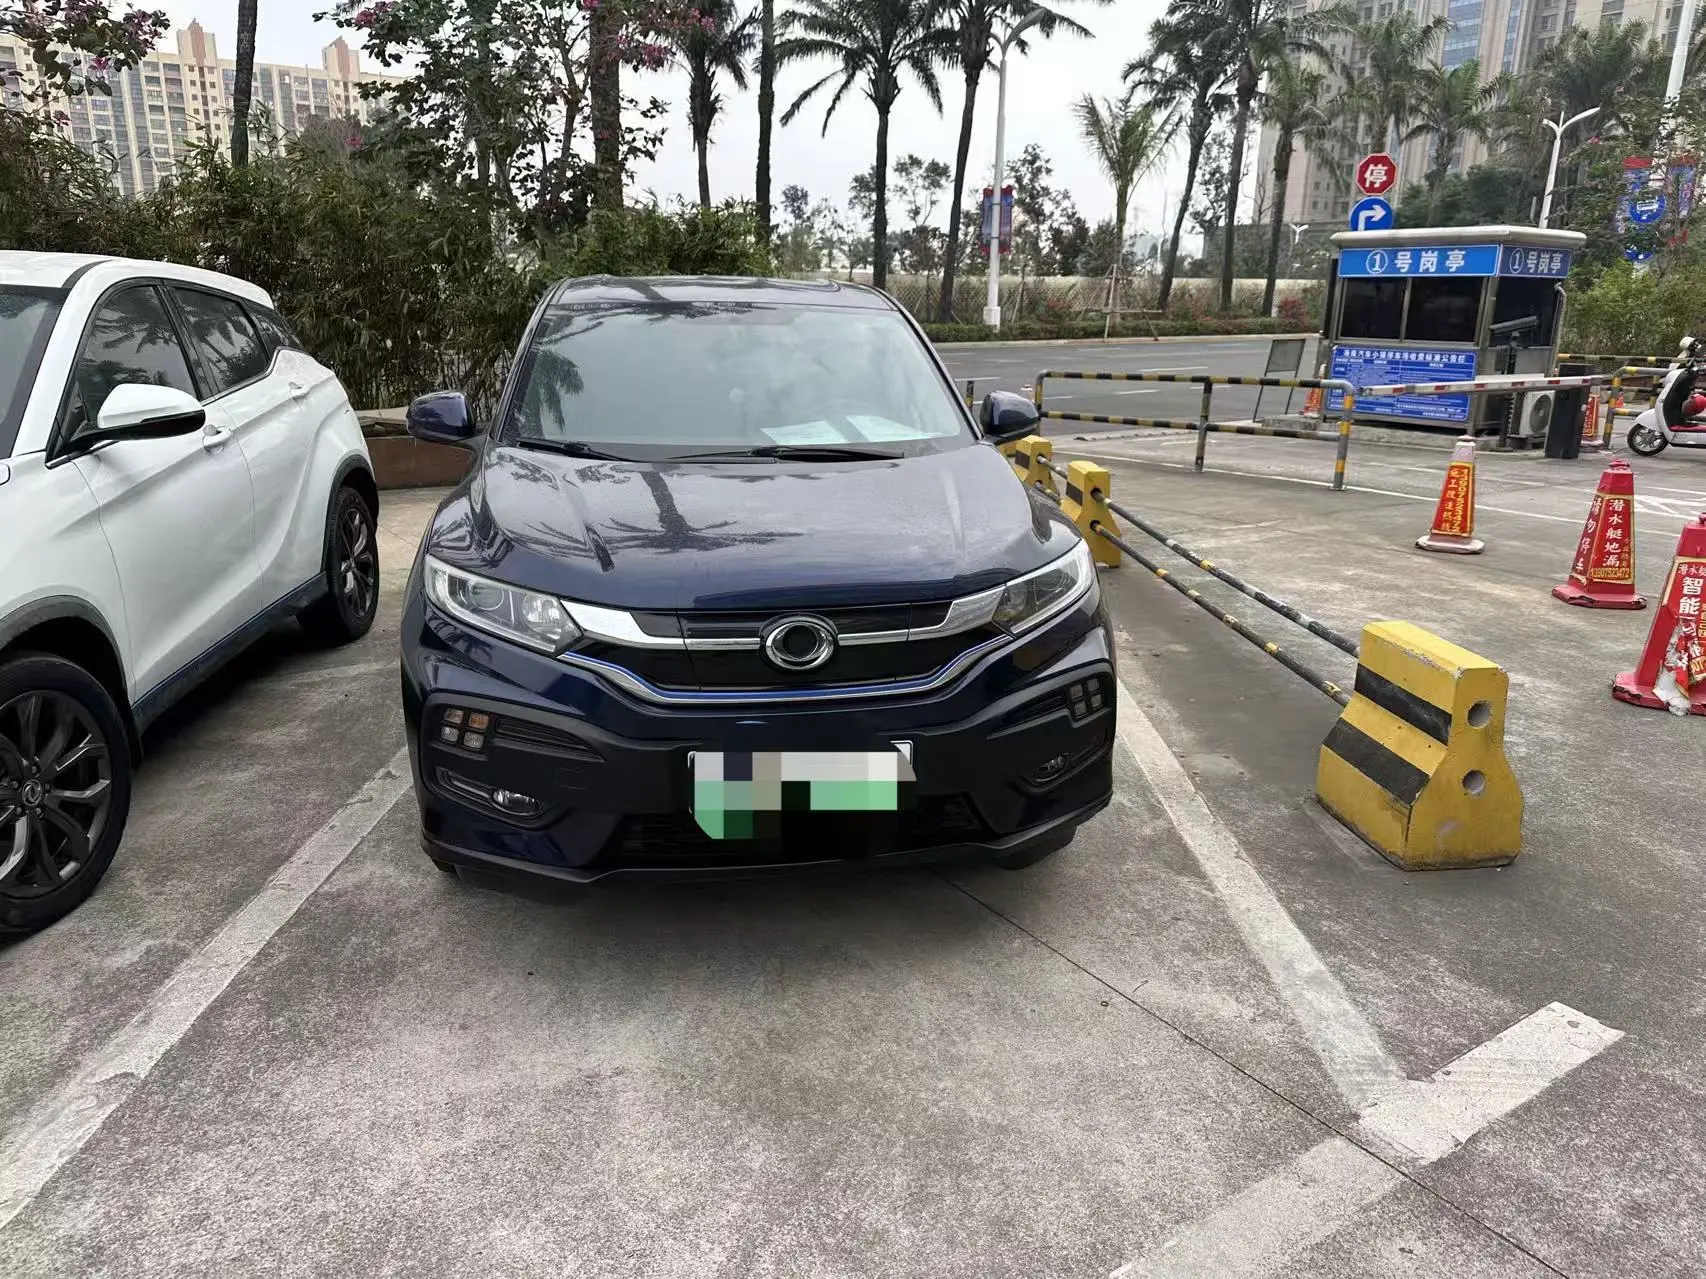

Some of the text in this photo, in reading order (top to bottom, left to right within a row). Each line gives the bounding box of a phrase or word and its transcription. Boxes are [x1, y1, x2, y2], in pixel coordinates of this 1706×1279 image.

[1364, 164, 1388, 188] 停
[1576, 497, 1601, 571] 请勿停车
[1603, 499, 1625, 567] 潜水艇地漏
